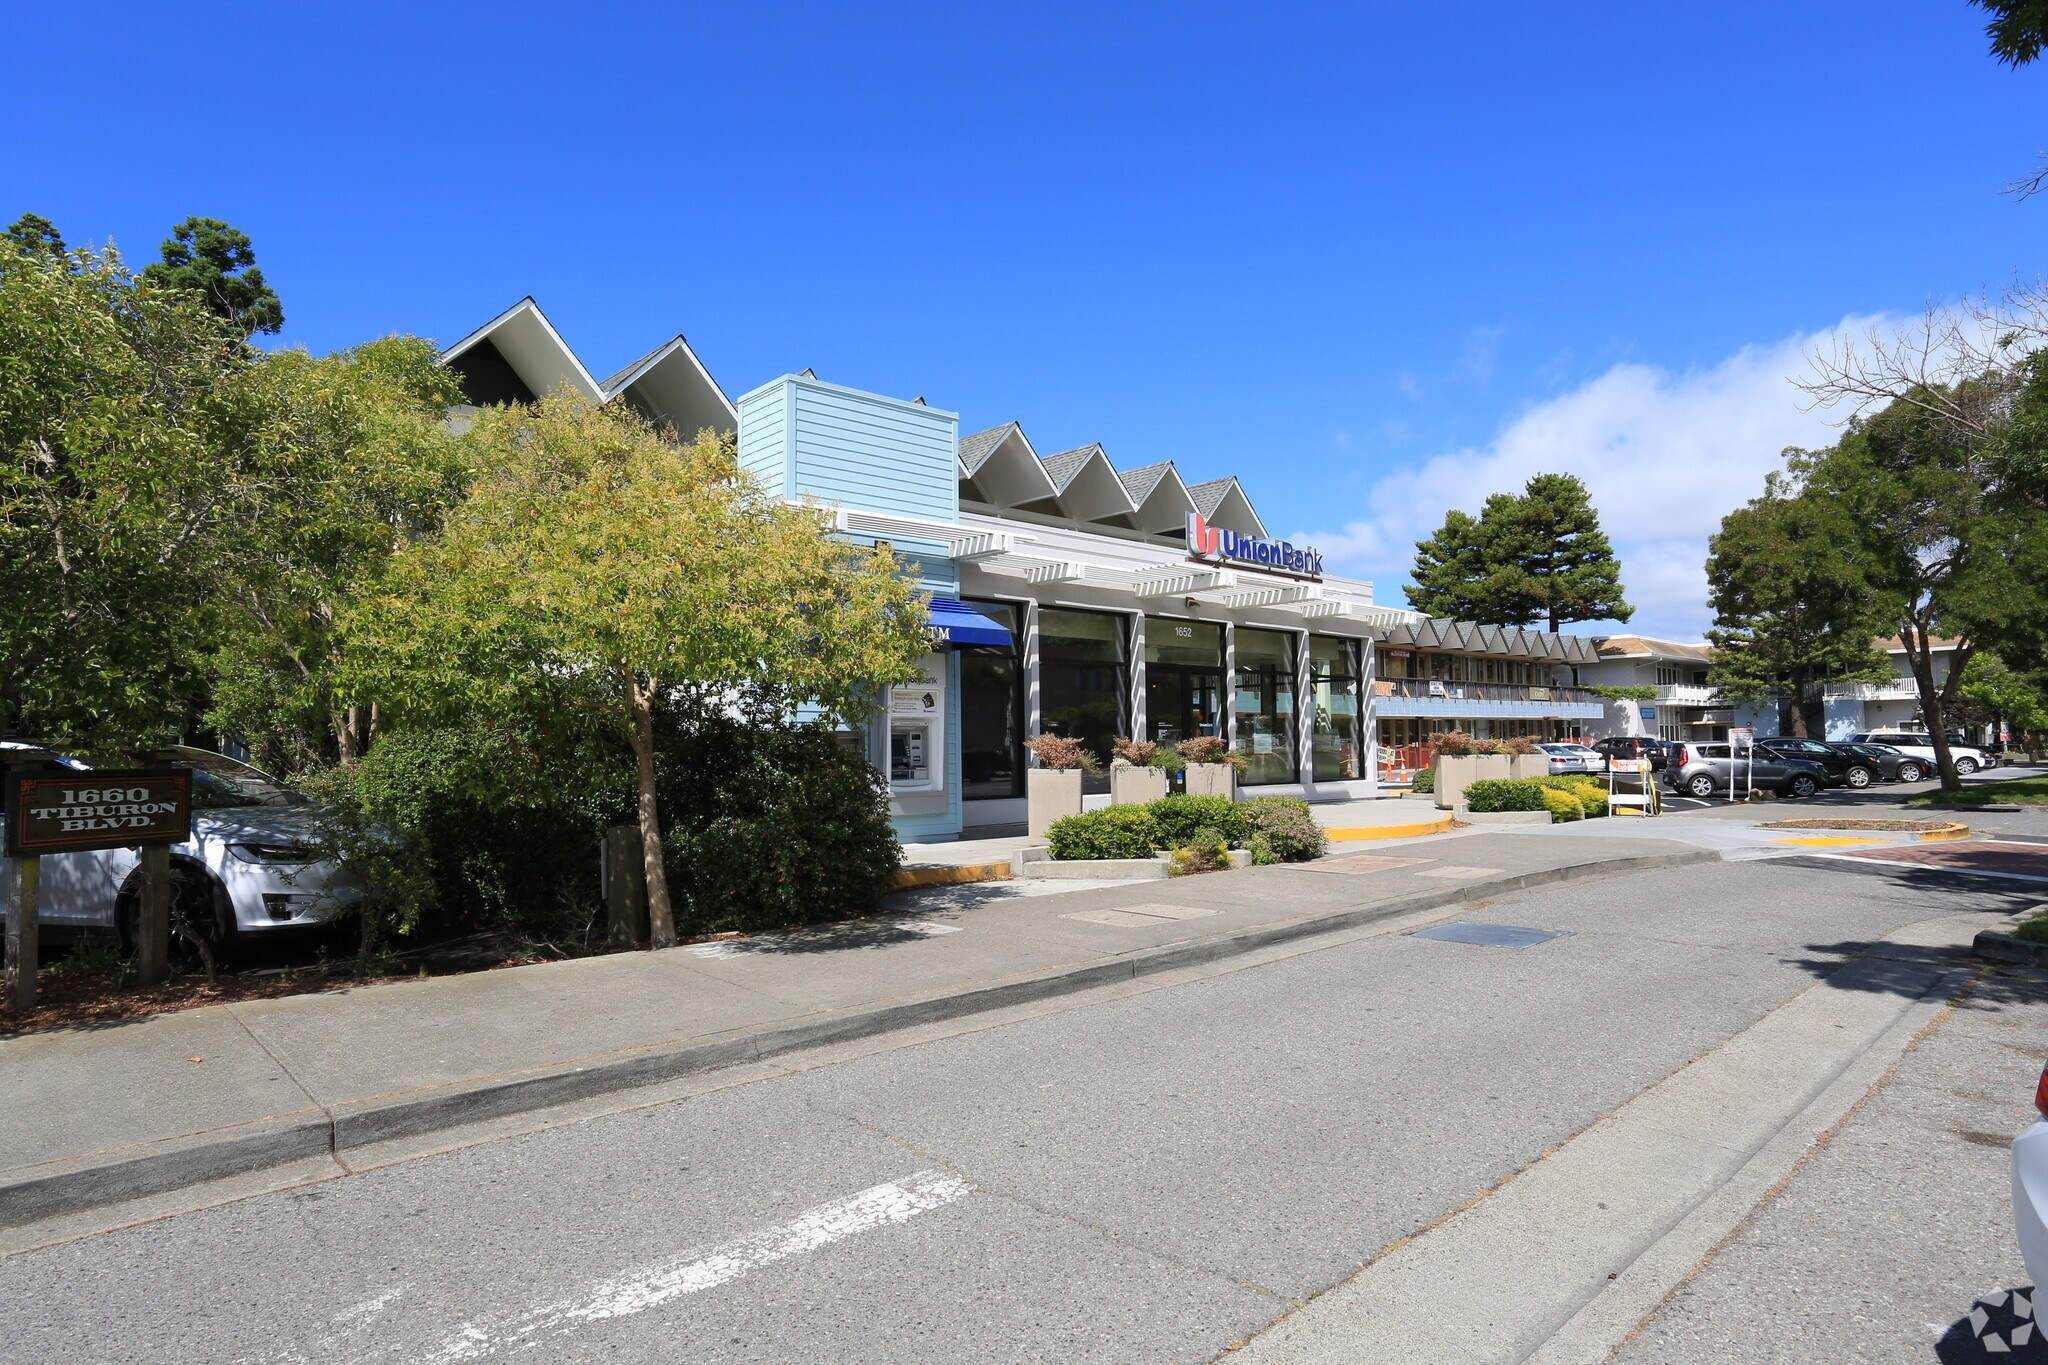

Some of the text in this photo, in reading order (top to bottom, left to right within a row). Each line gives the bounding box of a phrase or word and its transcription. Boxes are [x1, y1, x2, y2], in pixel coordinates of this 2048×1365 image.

[1220, 529, 1323, 573] UnionBank
[1175, 627, 1192, 638] 1652
[61, 788, 149, 804] 1660
[30, 802, 178, 820] TIBURON
[60, 816, 155, 832] BLVD.
